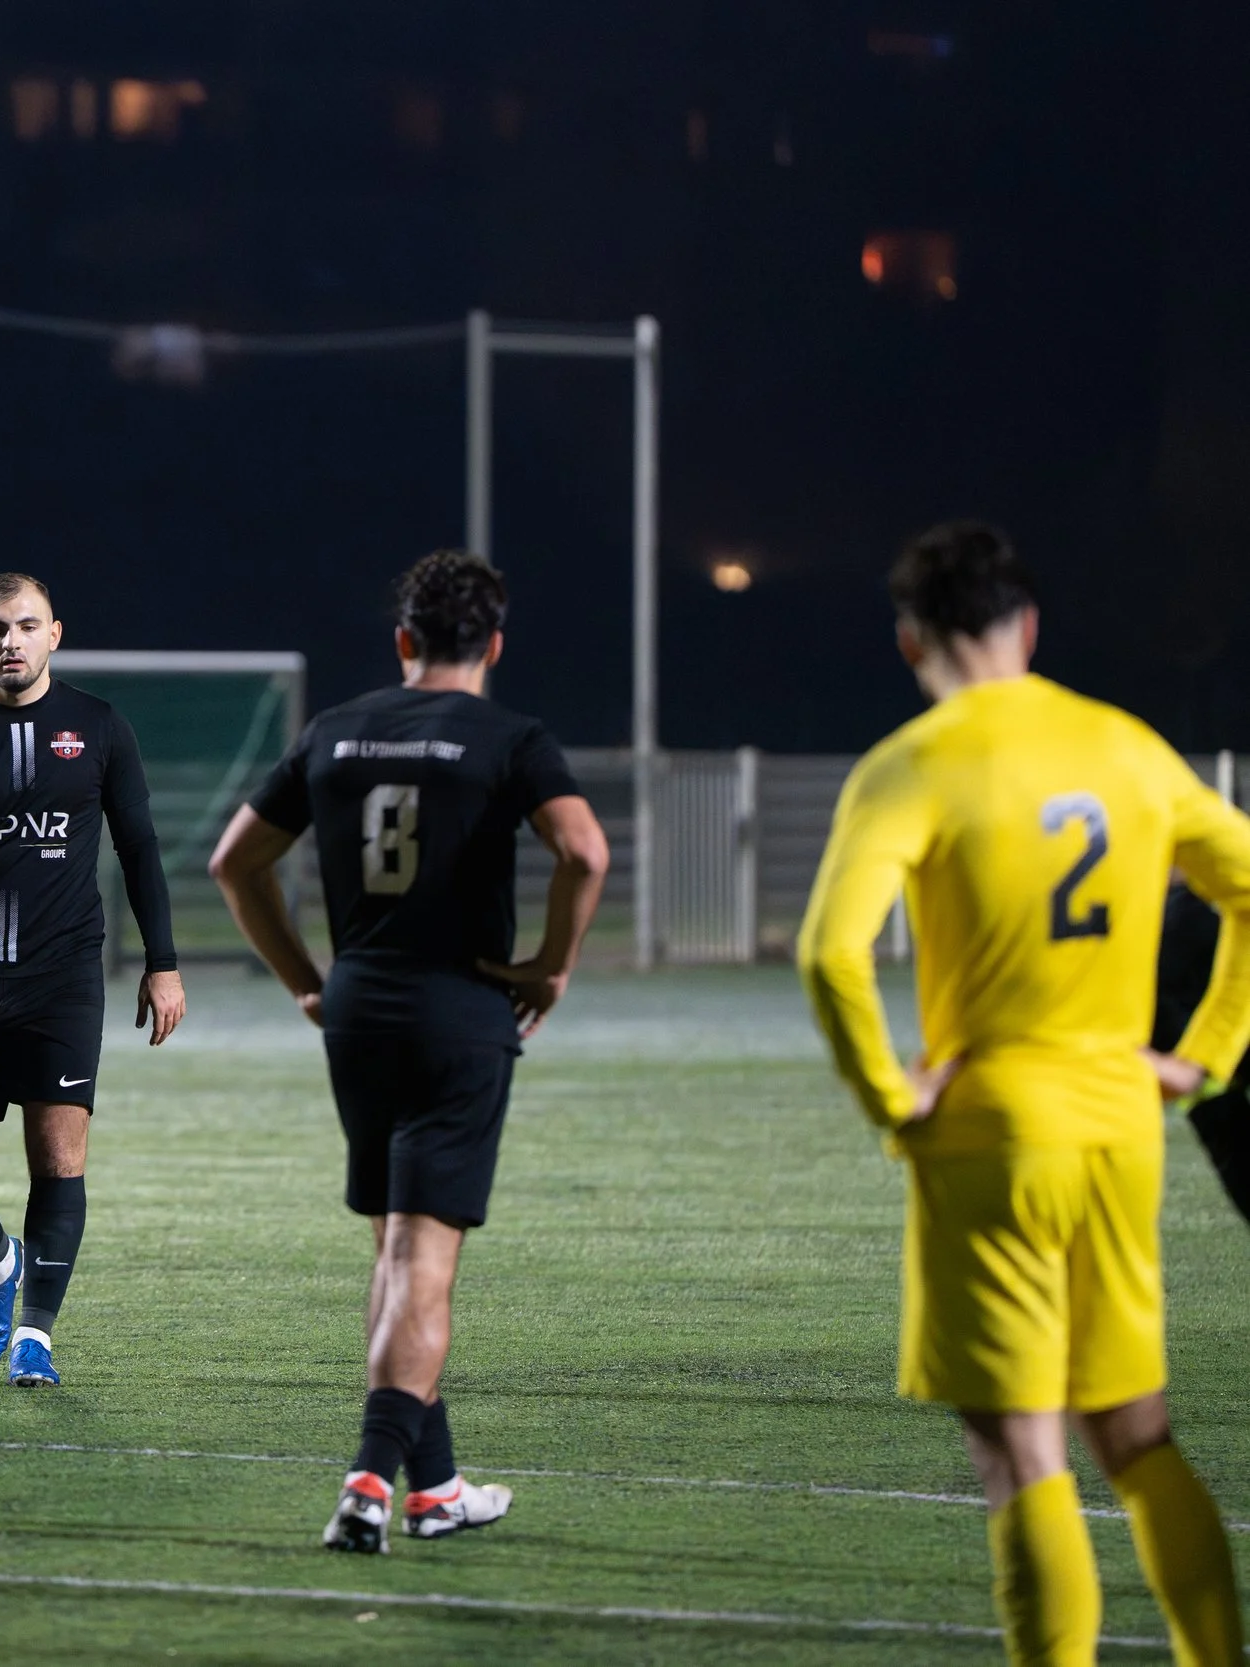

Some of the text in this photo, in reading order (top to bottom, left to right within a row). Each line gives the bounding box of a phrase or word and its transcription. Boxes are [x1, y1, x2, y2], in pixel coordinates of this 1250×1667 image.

[41, 849, 66, 859] GROUPE
[362, 783, 419, 894] 8
[1041, 791, 1109, 941] 2
